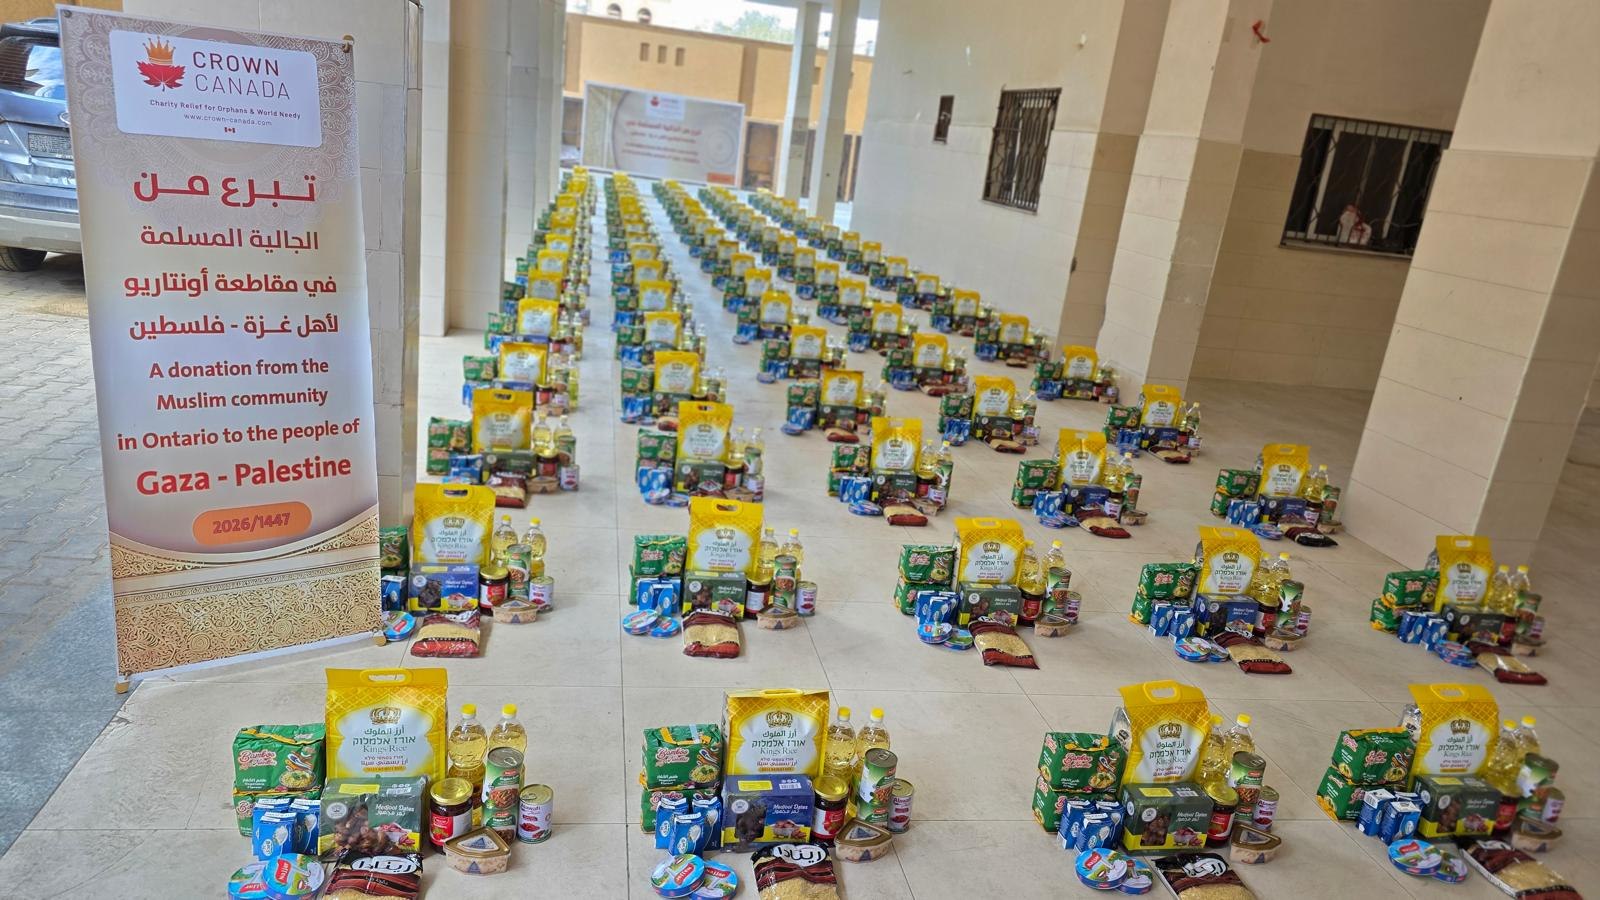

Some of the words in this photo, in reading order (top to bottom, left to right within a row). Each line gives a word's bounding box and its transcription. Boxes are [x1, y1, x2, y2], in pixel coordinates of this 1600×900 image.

[192, 51, 280, 77] CROWN
[195, 73, 290, 100] CANADA
[150, 100, 178, 109] Charity
[180, 102, 202, 110] Relief
[218, 106, 248, 114] Orphans
[257, 109, 278, 117] World
[280, 112, 300, 120] Needy
[184, 114, 272, 126] www.crown-canada.com
[133, 171, 210, 202] من
[221, 175, 316, 208] تبرع
[140, 226, 243, 248] المسلمة
[249, 229, 319, 254] الجالية
[124, 268, 209, 298] أونتاريو
[214, 274, 298, 293] مقاطعة
[303, 276, 337, 298] في
[130, 315, 225, 341] فلسطين
[244, 314, 291, 339] غزة
[297, 313, 339, 338] لأهل
[149, 363, 164, 379] A
[168, 360, 252, 379] donation
[256, 359, 298, 376] from
[302, 358, 329, 374] the
[157, 392, 227, 411] Muslim
[231, 388, 328, 407] community
[118, 433, 138, 451] in
[142, 429, 218, 449] Ontario
[223, 427, 243, 444] to
[247, 424, 278, 442] the
[282, 420, 339, 444] people
[342, 418, 361, 434] of
[136, 470, 210, 496] Gaza
[235, 456, 352, 487] Palestine
[213, 512, 290, 535] 2026/1447
[364, 728, 392, 737] الملوك
[394, 724, 405, 736] أرز
[394, 736, 416, 744] אורז
[763, 730, 786, 740] الملوك
[788, 728, 797, 739] أرز
[364, 745, 388, 754] Kings
[390, 744, 408, 752] Rice
[760, 748, 781, 756] Kings
